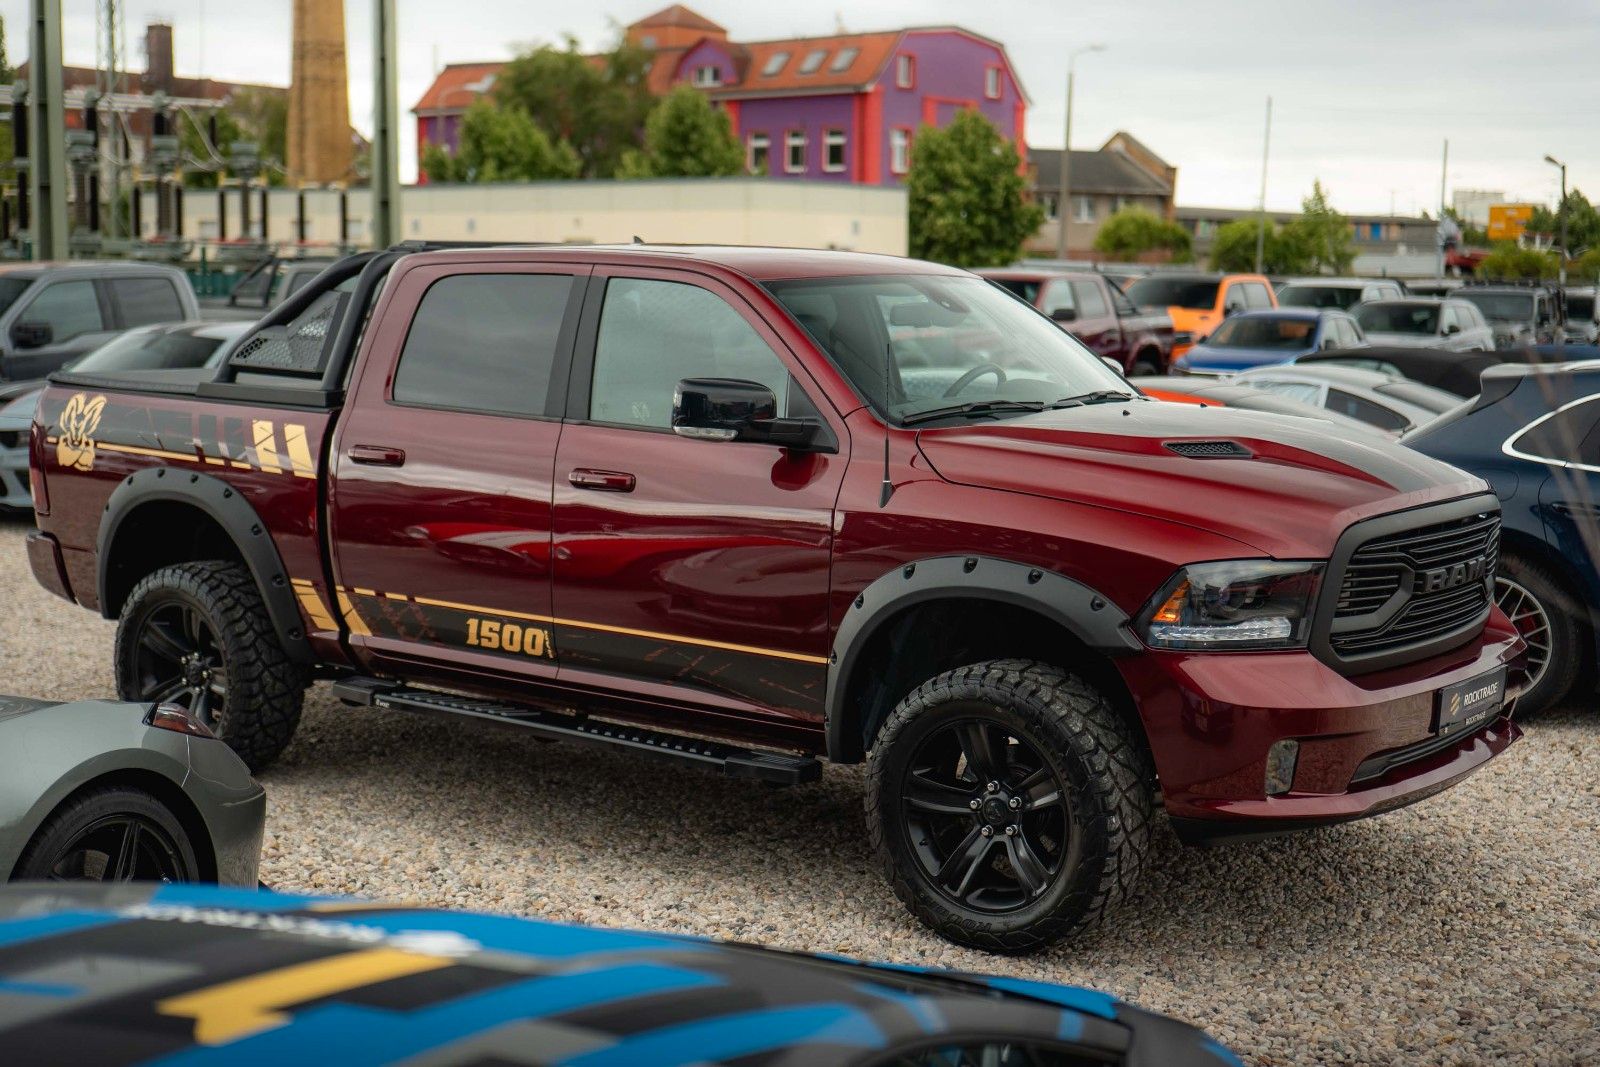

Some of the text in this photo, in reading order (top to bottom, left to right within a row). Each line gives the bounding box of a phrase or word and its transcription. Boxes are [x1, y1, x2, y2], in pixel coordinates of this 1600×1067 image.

[1424, 554, 1486, 593] RAM
[466, 618, 545, 656] 1500
[1463, 681, 1499, 706] ROCKTRADE
